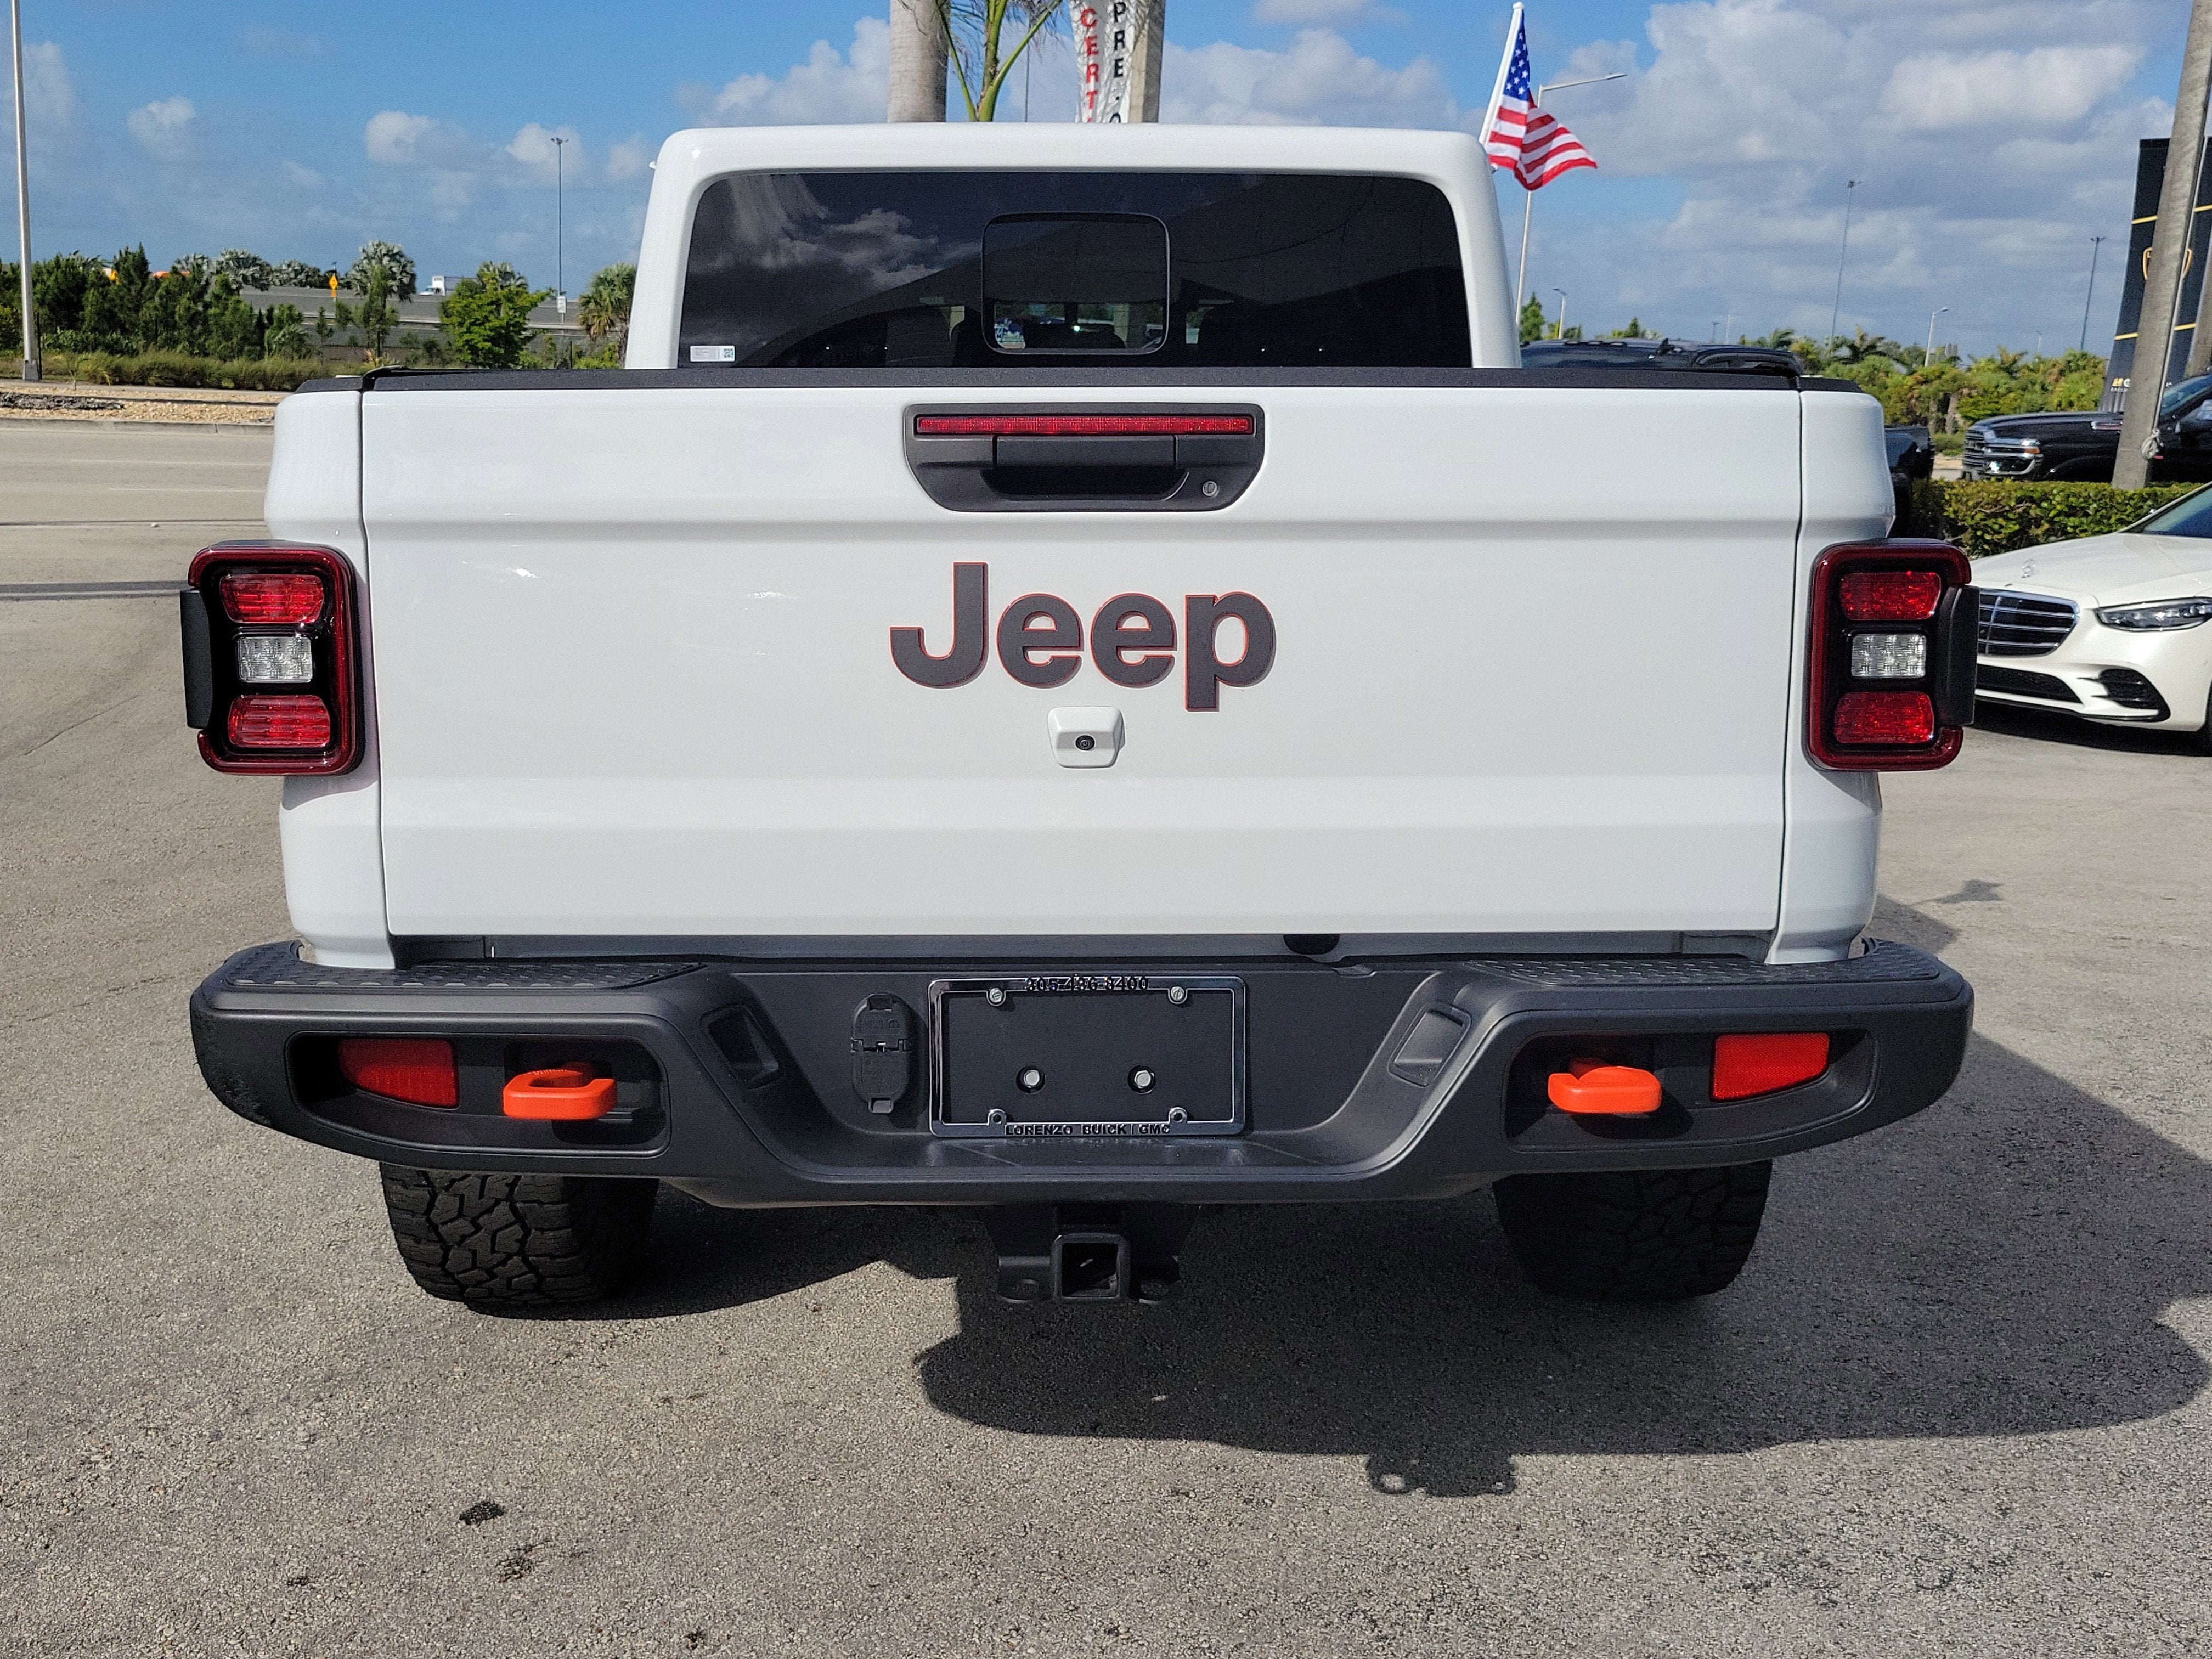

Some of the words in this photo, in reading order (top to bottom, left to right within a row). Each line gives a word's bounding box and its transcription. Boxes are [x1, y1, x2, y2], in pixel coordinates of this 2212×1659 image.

[1081, 8, 1099, 123] CERT
[889, 561, 1276, 712] Jeep
[1024, 976, 1149, 992] 305-436-8400
[1005, 1124, 1073, 1136] LORENZO
[1081, 1124, 1127, 1136] BUICK
[1138, 1124, 1171, 1135] GMC
